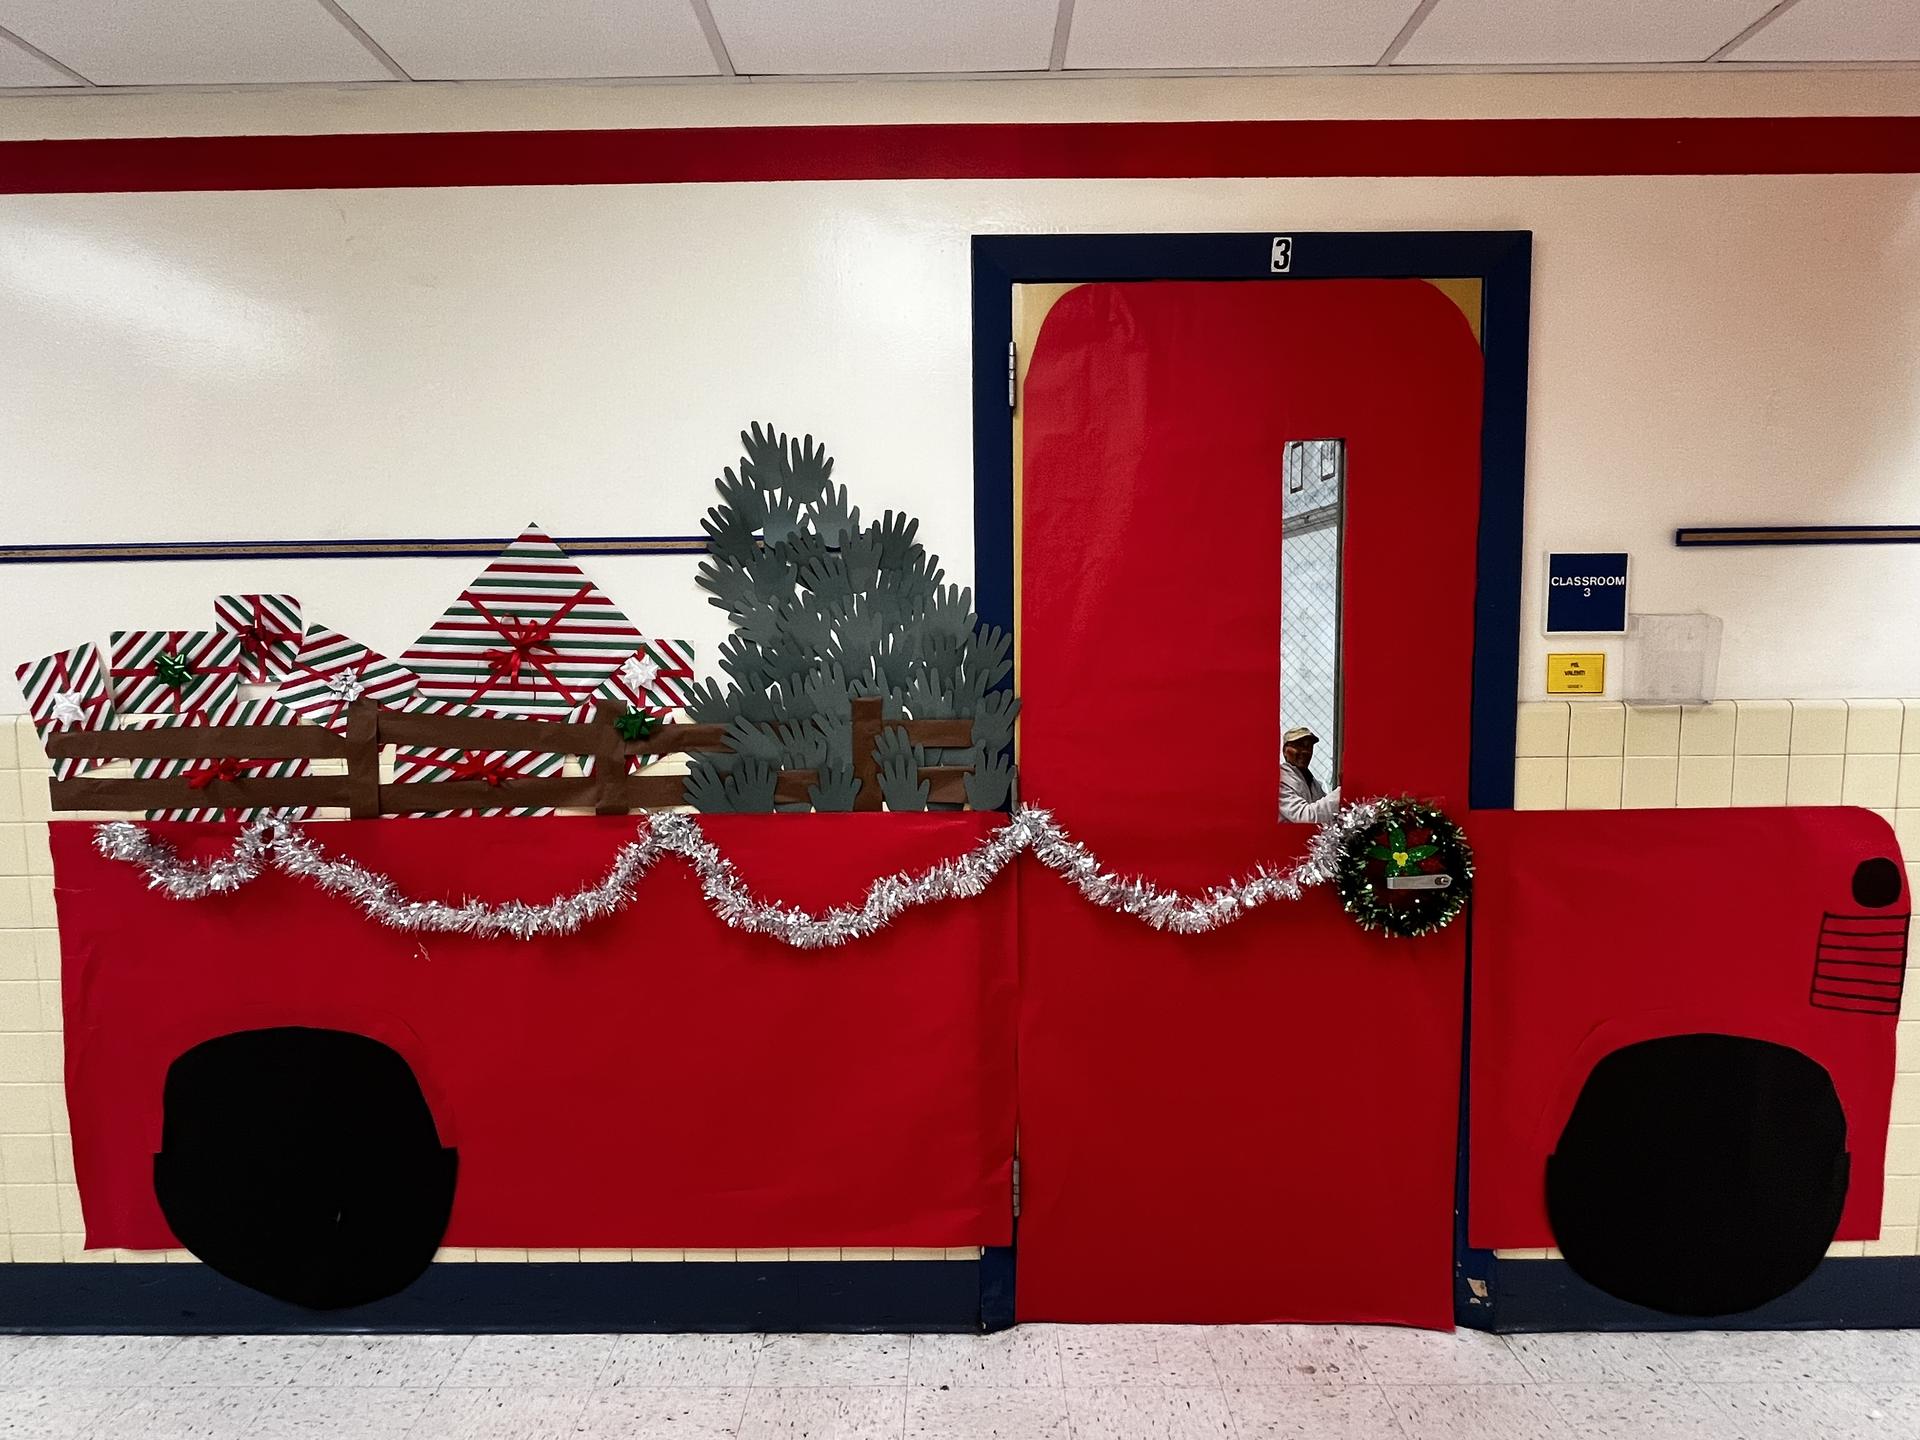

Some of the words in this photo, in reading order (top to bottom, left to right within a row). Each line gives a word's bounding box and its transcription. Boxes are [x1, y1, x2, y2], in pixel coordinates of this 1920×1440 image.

[1273, 239, 1291, 270] 3
[1551, 576, 1625, 586] CLASSROOM
[1583, 587, 1591, 597] 3
